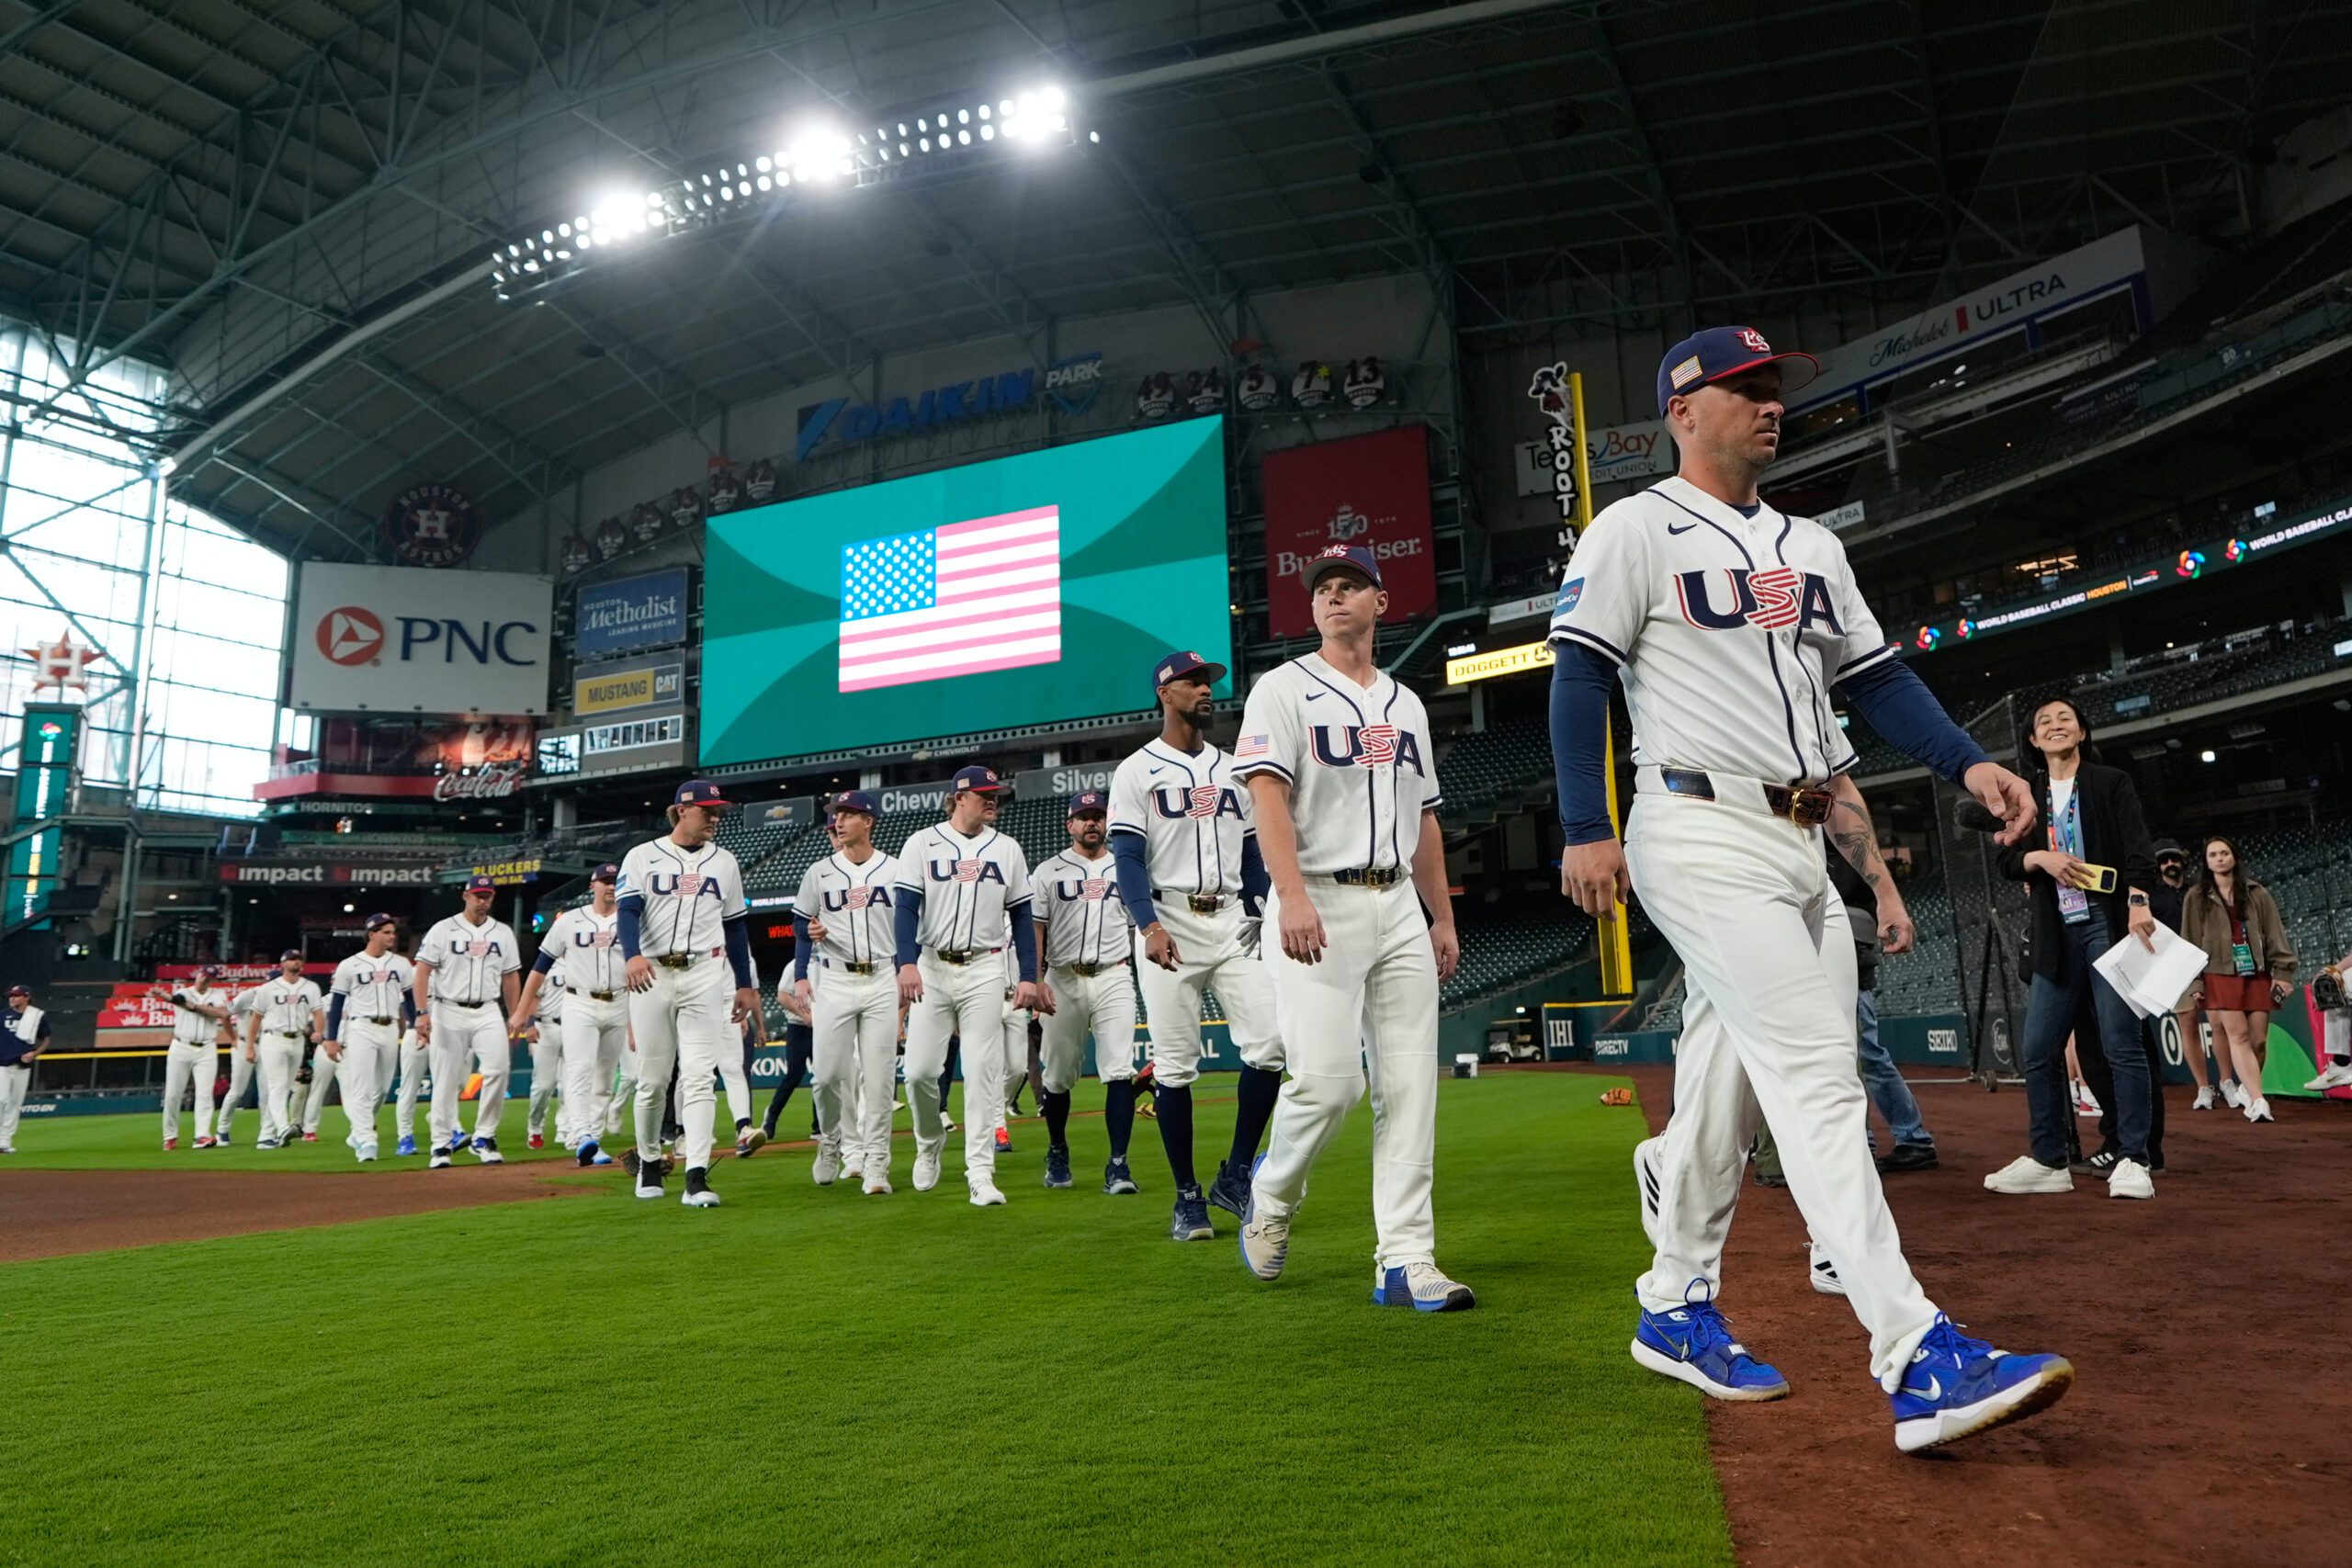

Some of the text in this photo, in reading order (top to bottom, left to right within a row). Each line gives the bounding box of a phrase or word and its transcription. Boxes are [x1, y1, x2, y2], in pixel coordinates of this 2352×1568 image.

[1869, 275, 2066, 367] Michelob ULTRA
[1299, 360, 1318, 389] 7
[1345, 355, 1379, 387] 13
[837, 360, 1102, 442] DAIKIN PARK
[1607, 431, 1658, 459] Bay
[1549, 426, 1576, 517] ROOT
[1617, 461, 1657, 476] UNION
[399, 486, 470, 511] HOUSTON
[414, 509, 450, 539] H
[2249, 531, 2285, 550] WORLD
[2285, 514, 2336, 539] BASEBALL
[582, 595, 677, 632] Methodist
[583, 598, 622, 611] HOUSTON
[1672, 567, 1847, 637] USA
[1976, 613, 2008, 630] WORLD
[2007, 604, 2051, 623] BASEBALL
[2051, 592, 2086, 611] CLASSIC
[2086, 580, 2128, 600] HOUSTON
[395, 616, 537, 666] PNC
[33, 641, 87, 684] H
[1455, 652, 1530, 677] DOGGETT
[588, 673, 679, 704] MUSTANG CAT
[933, 744, 980, 758] CHEVROLET
[1308, 724, 1426, 779] USA
[300, 801, 372, 814] HORNITOS
[880, 788, 944, 813] Chevy
[1150, 784, 1246, 821] USA
[238, 864, 323, 885] impact
[350, 865, 433, 886] impact
[472, 859, 541, 877] PLUCKERS
[926, 857, 1006, 886] USA
[648, 873, 724, 901] USA
[820, 885, 893, 912] USA
[1057, 877, 1125, 907] USA
[450, 940, 503, 958] USA
[356, 970, 401, 986] USA
[1548, 1020, 1574, 1047] IHI
[1595, 1039, 1629, 1055] DIRECTV
[1928, 1029, 1958, 1053] SEIKO
